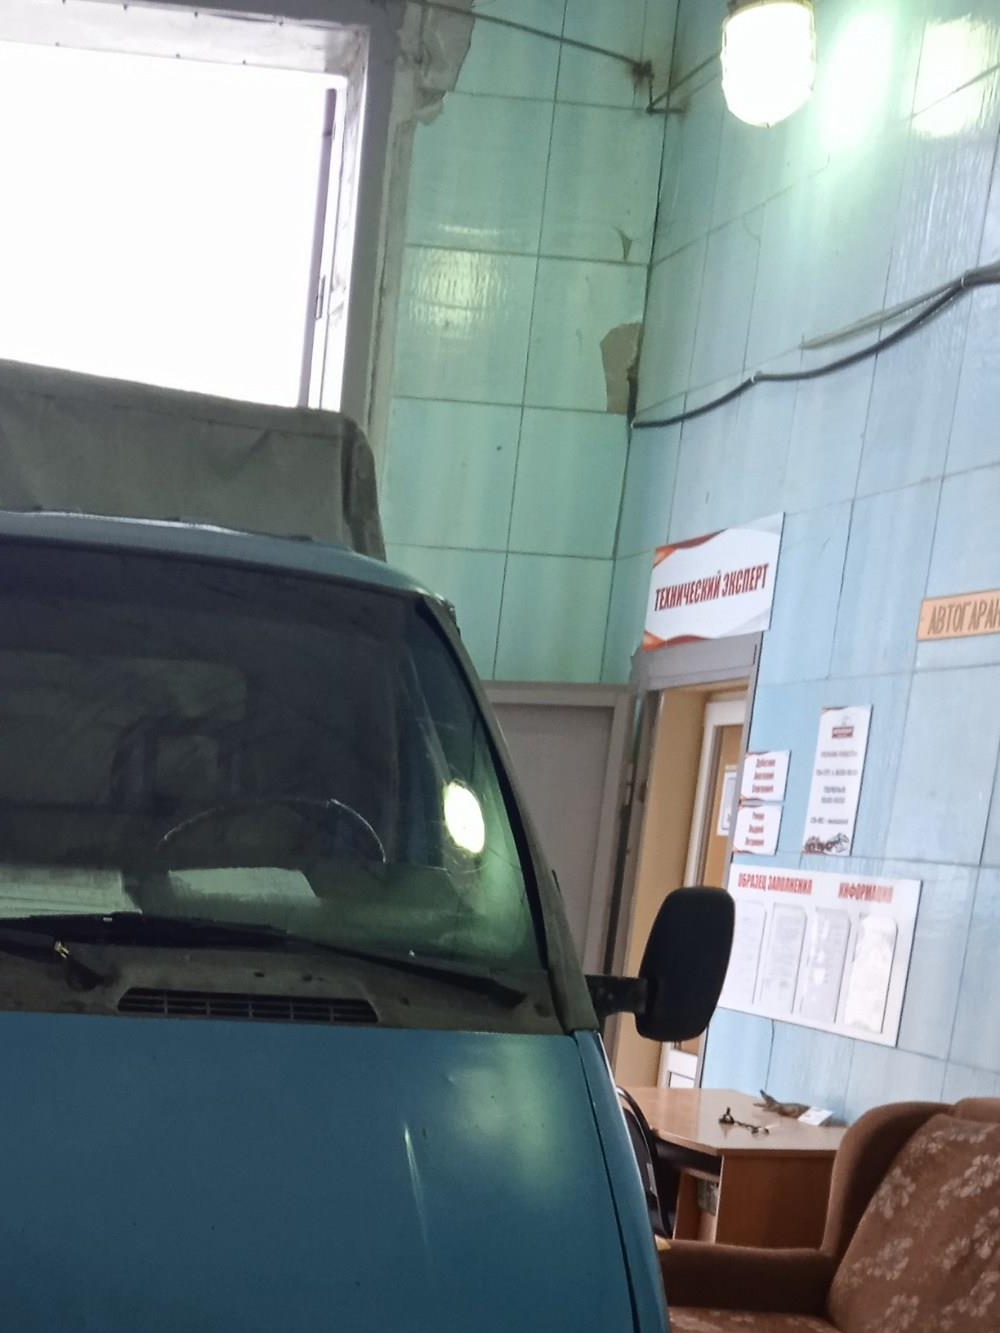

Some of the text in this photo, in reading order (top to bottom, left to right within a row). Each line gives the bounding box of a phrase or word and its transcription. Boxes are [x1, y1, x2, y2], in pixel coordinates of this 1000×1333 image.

[654, 563, 769, 611] ТЕХНИЧЕСКИЙ ЭКСПЕРТ
[738, 872, 767, 892] ОБРАЗЕЦ
